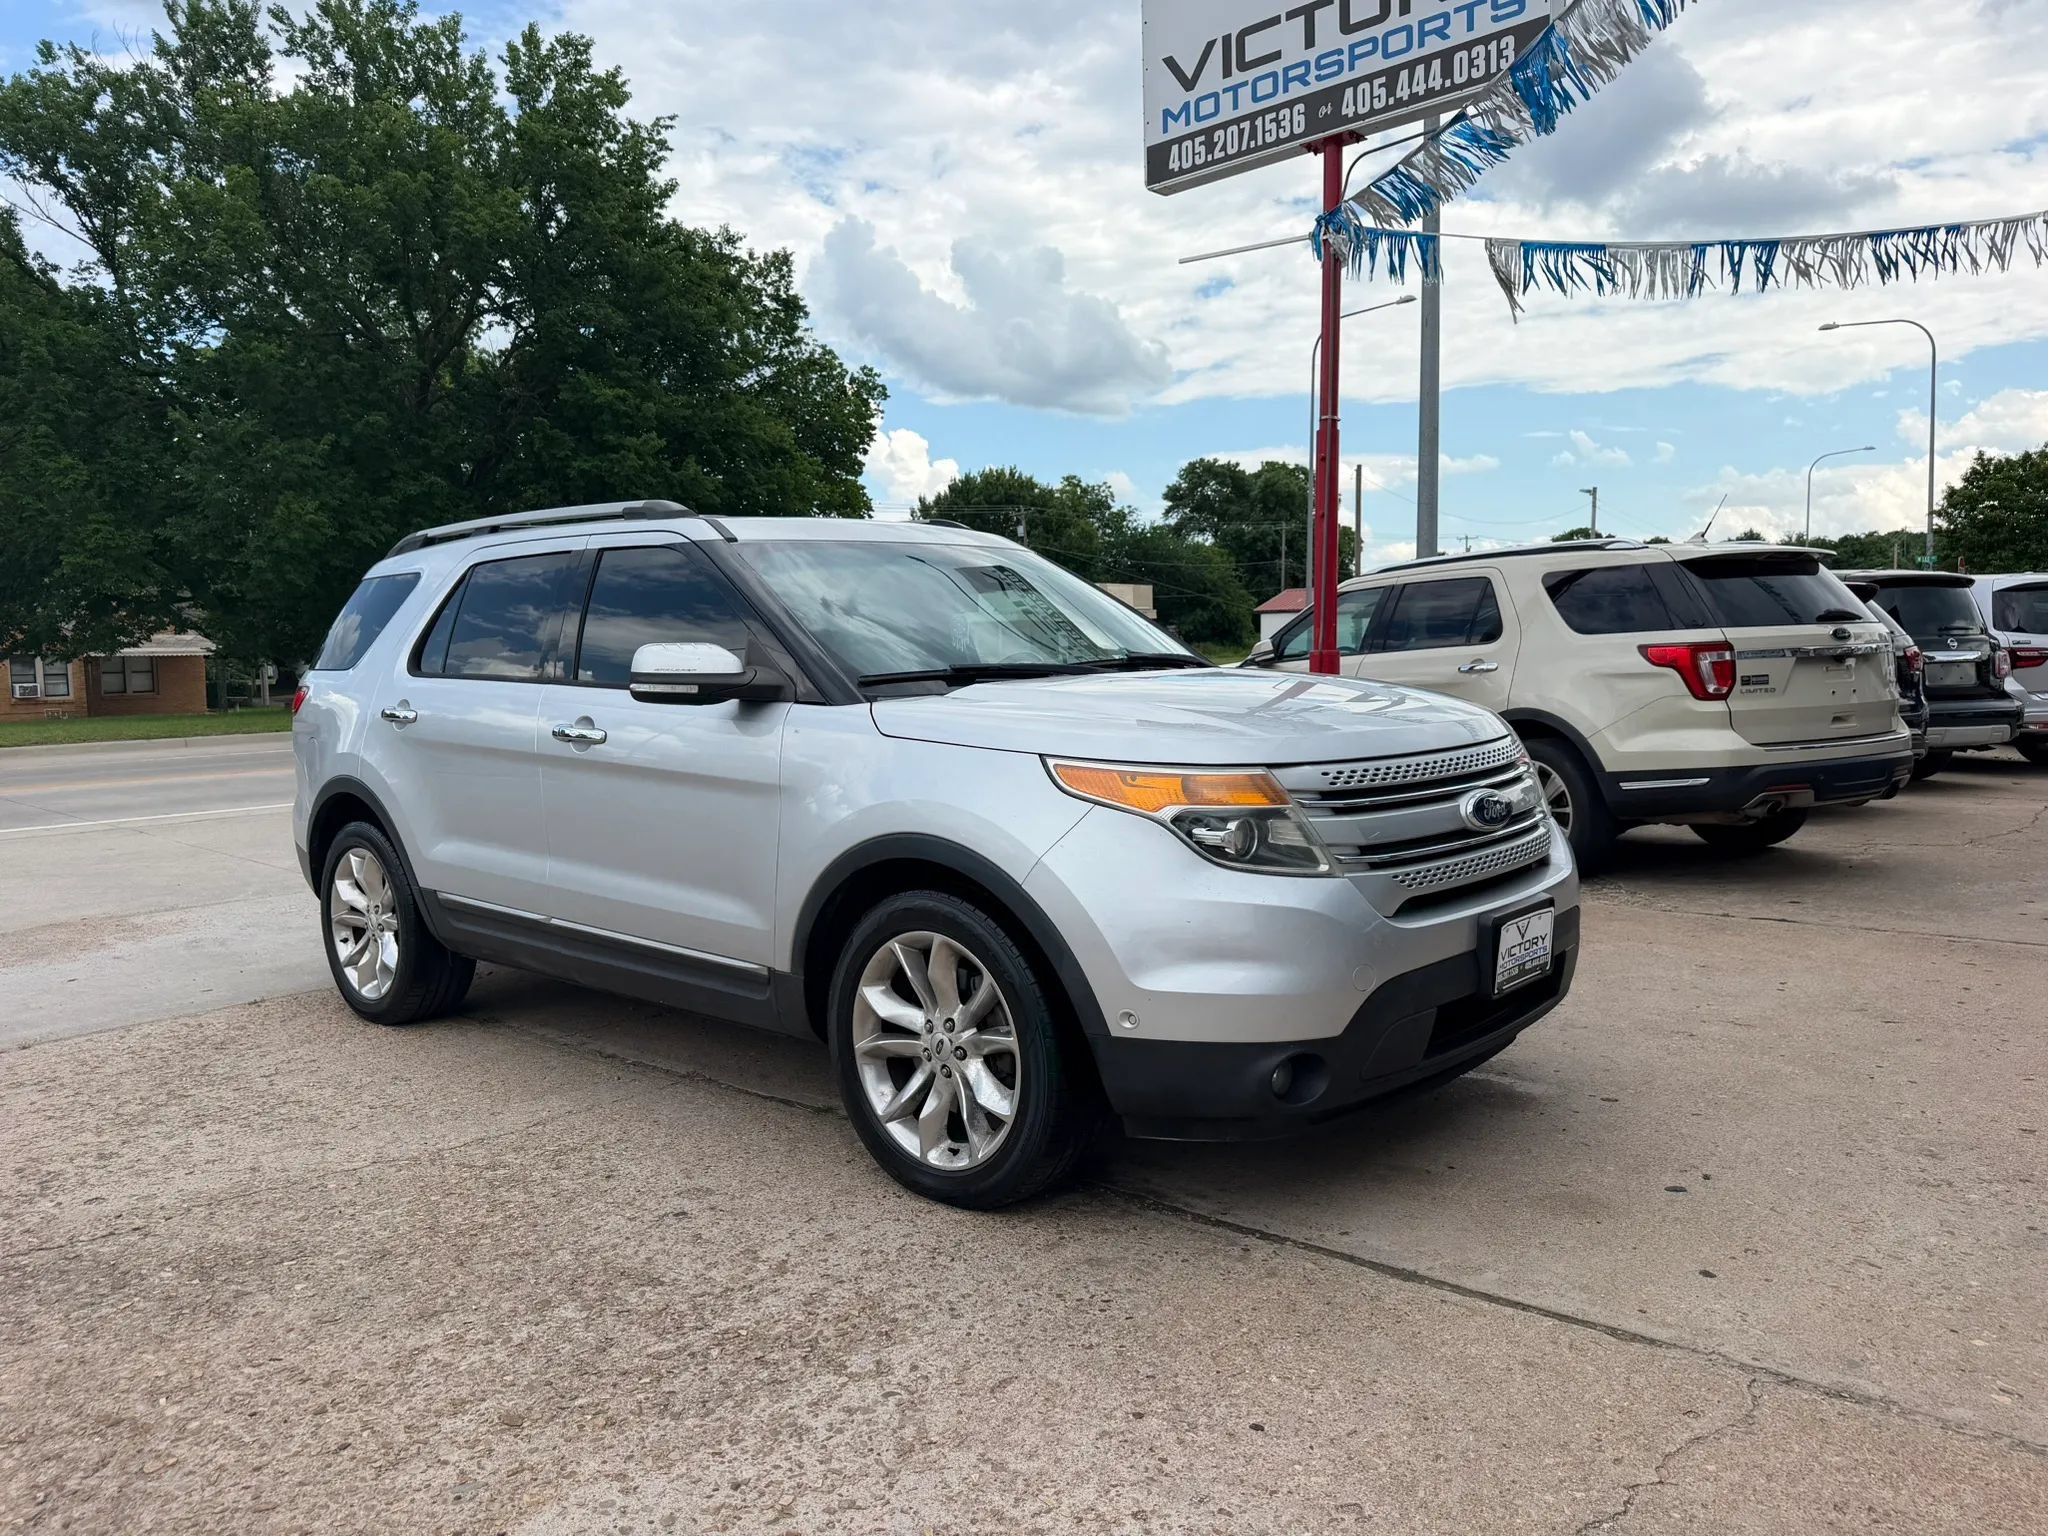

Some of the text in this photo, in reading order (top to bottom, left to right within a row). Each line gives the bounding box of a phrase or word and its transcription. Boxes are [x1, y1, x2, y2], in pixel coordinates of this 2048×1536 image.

[1162, 0, 1443, 92] VICTO
[1162, 0, 1525, 134] MOTORSPORTS
[1168, 35, 1514, 172] 405.207.1536 or 405.444.0313
[1501, 933, 1548, 961] VICTORY
